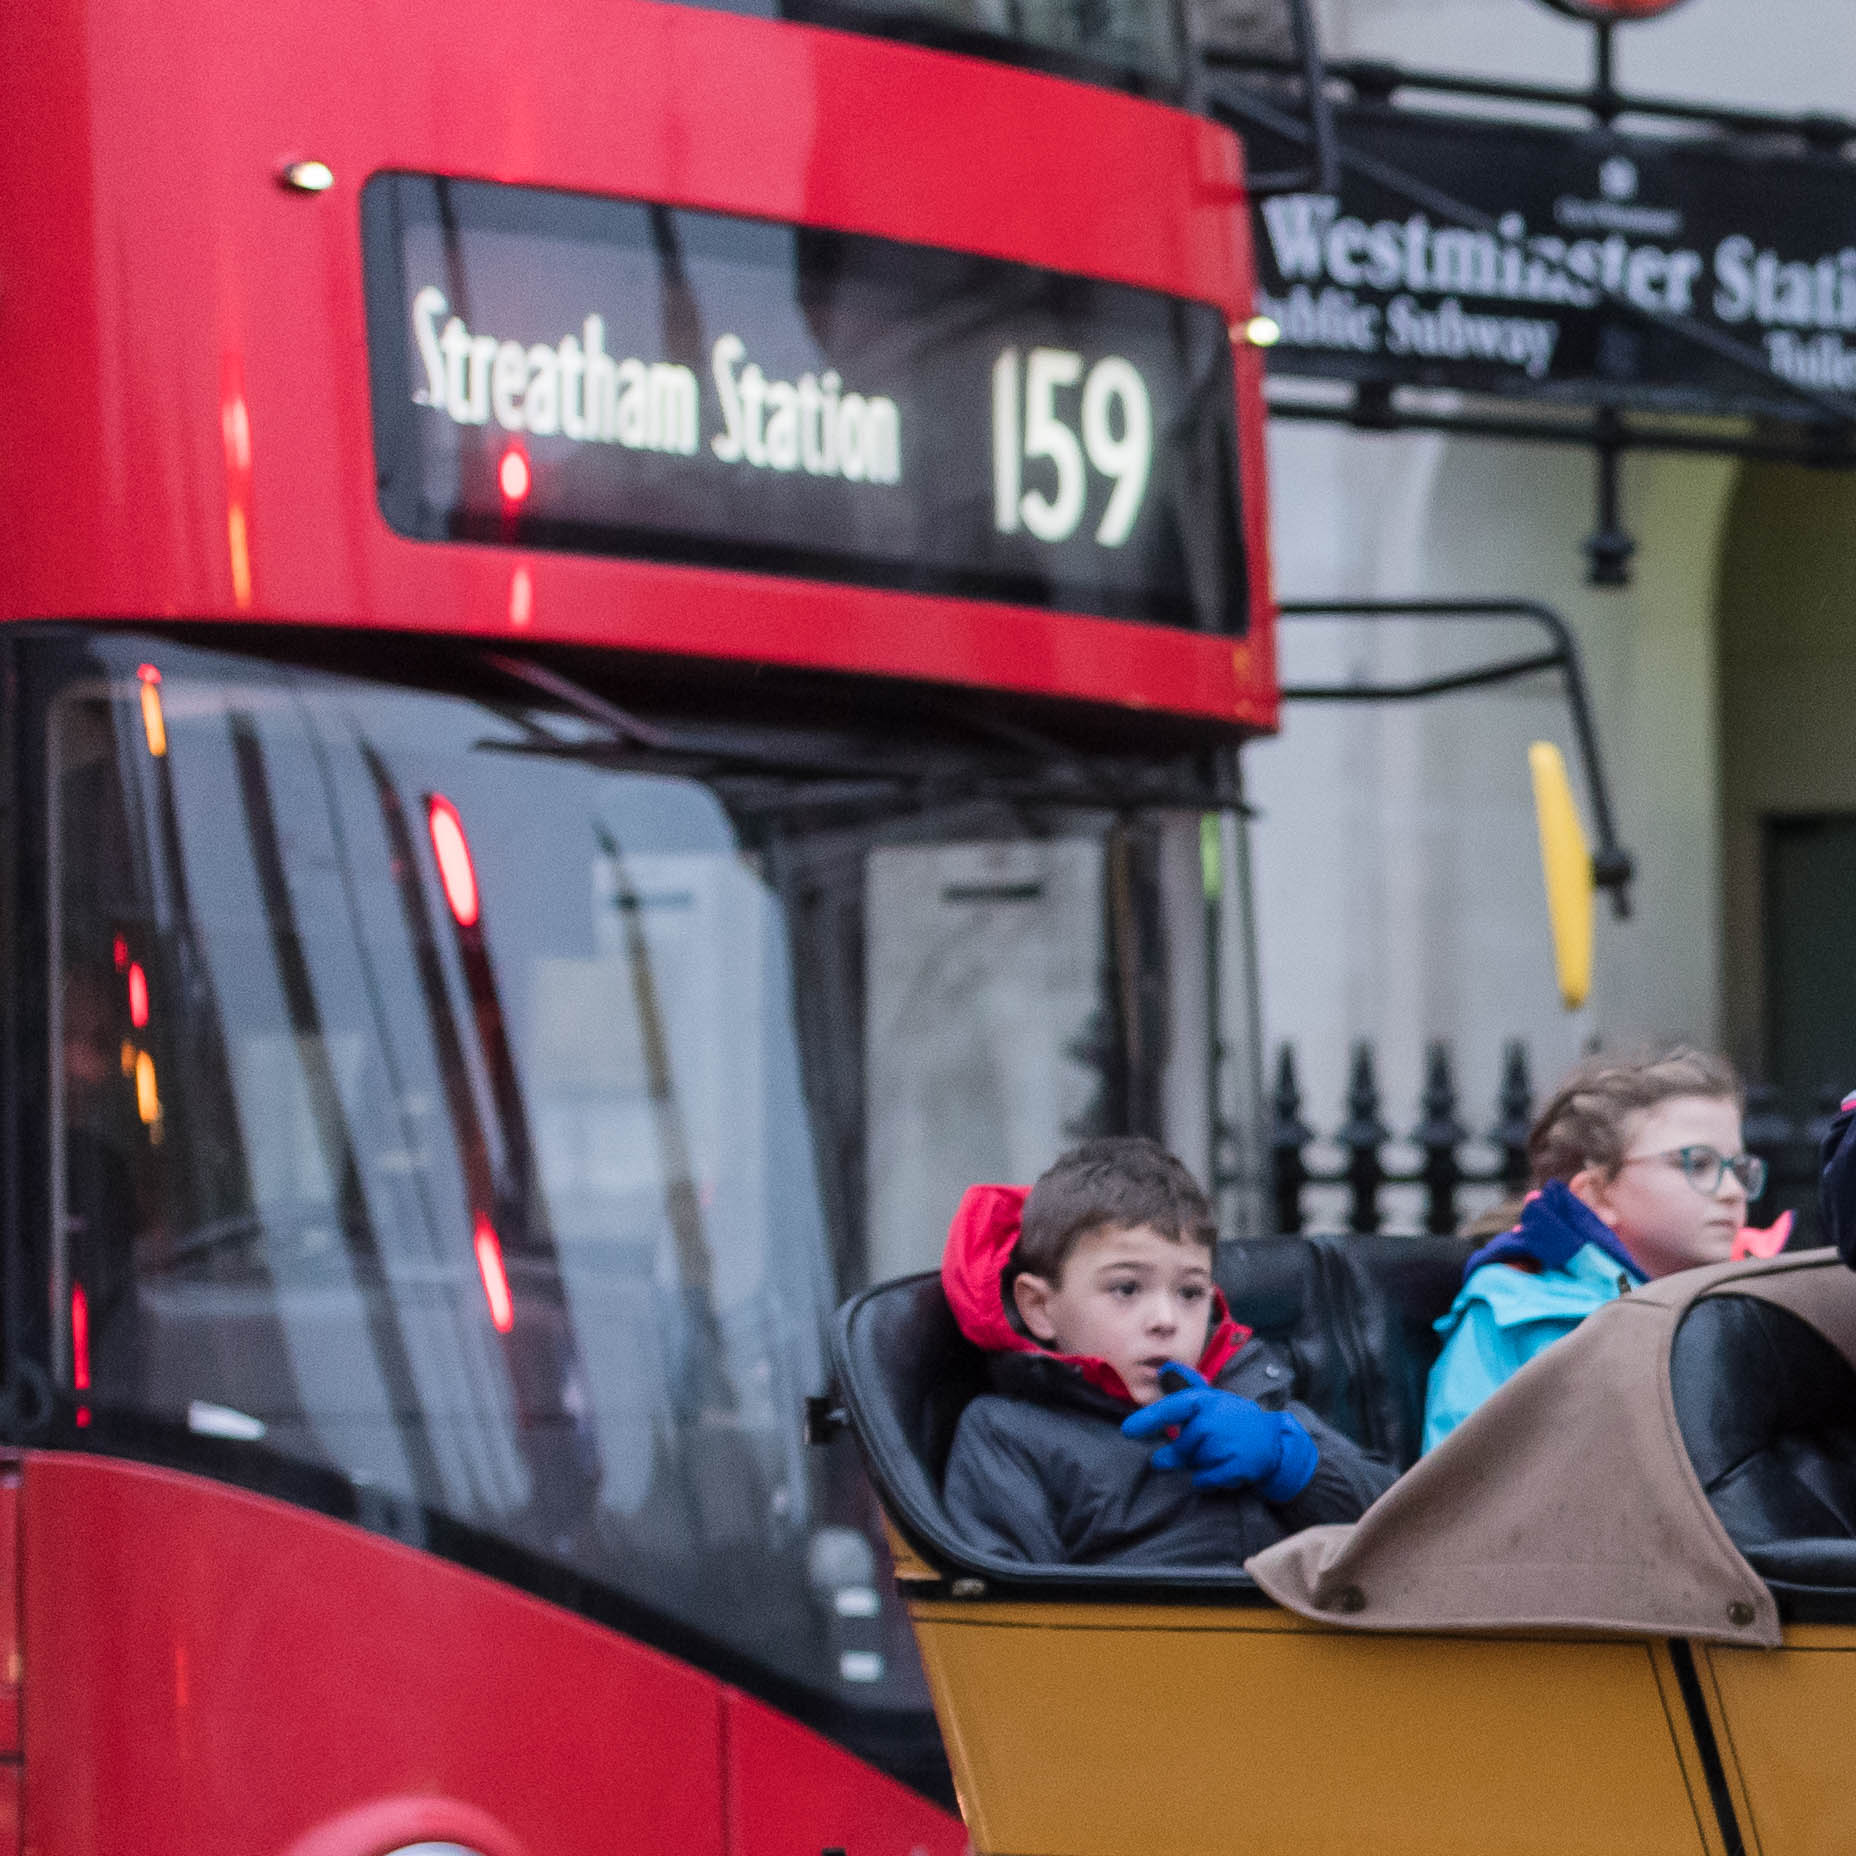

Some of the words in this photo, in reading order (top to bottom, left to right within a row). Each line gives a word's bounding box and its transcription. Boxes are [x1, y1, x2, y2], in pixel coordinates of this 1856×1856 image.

[1261, 193, 1702, 314] Westminster
[413, 285, 699, 456] Streatham
[711, 333, 900, 484] Station
[1386, 294, 1560, 379] Subway
[992, 348, 1153, 547] 159
